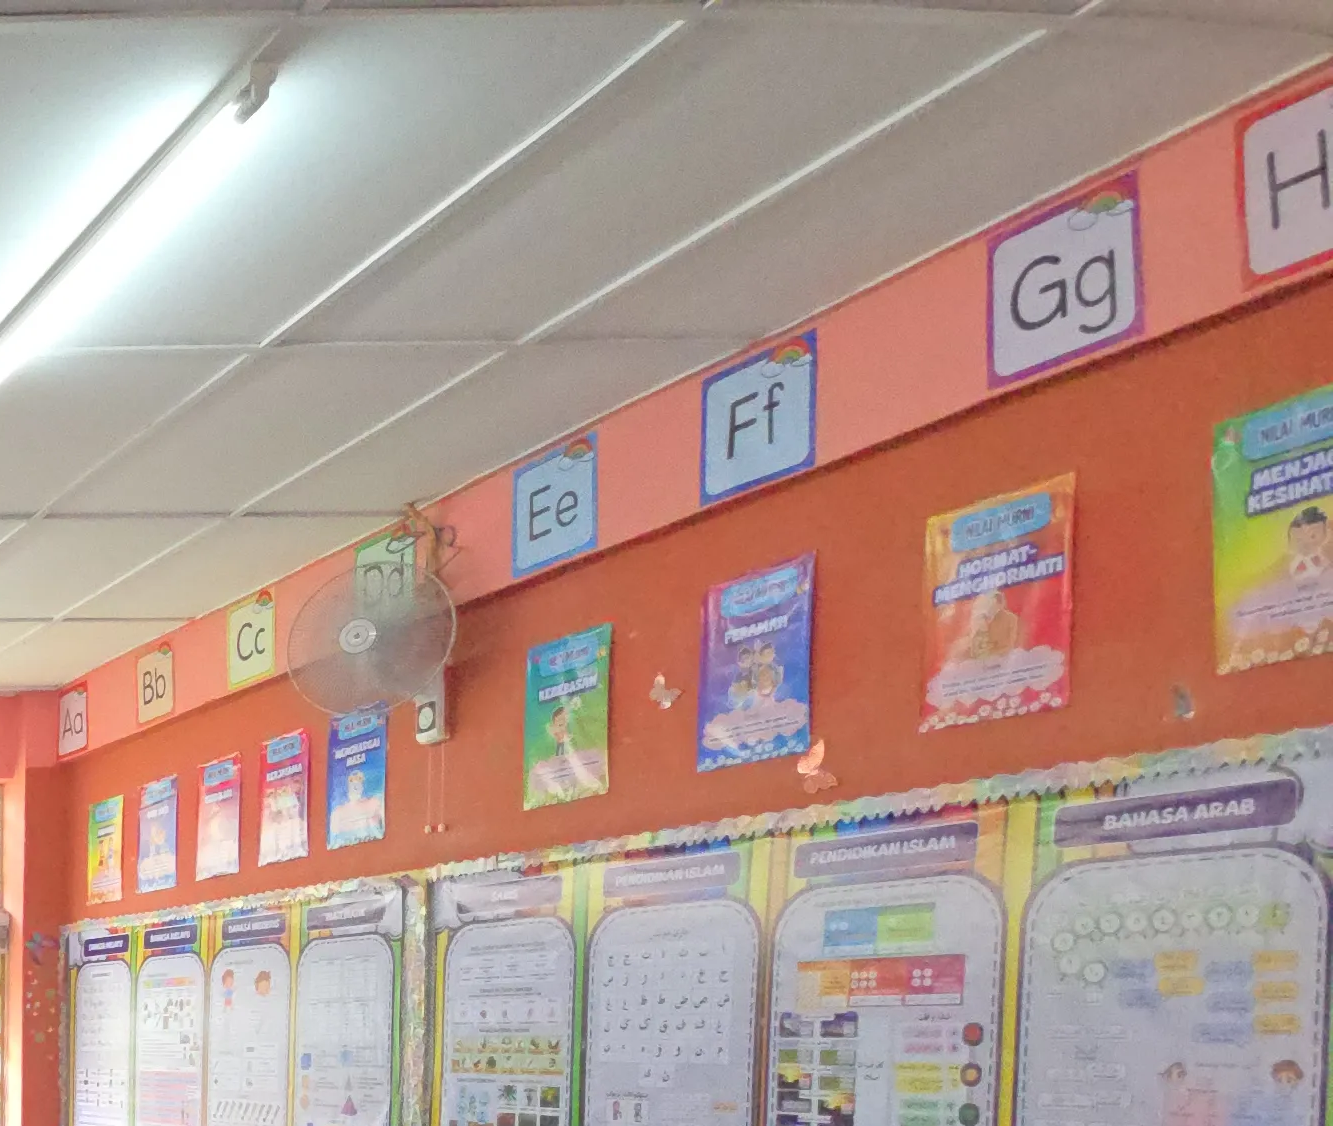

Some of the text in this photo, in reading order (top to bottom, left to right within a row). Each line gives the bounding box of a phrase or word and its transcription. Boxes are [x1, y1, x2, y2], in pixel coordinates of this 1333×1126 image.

[1009, 246, 1119, 334] Gg
[727, 382, 785, 460] Ff
[528, 487, 579, 542] Ee
[237, 622, 266, 661] Cc
[143, 668, 166, 706] Bb
[63, 708, 83, 741] Aa
[1102, 798, 1256, 831] BAHASA ARAB
[810, 836, 956, 864] PENDIDIKAN ISLAM
